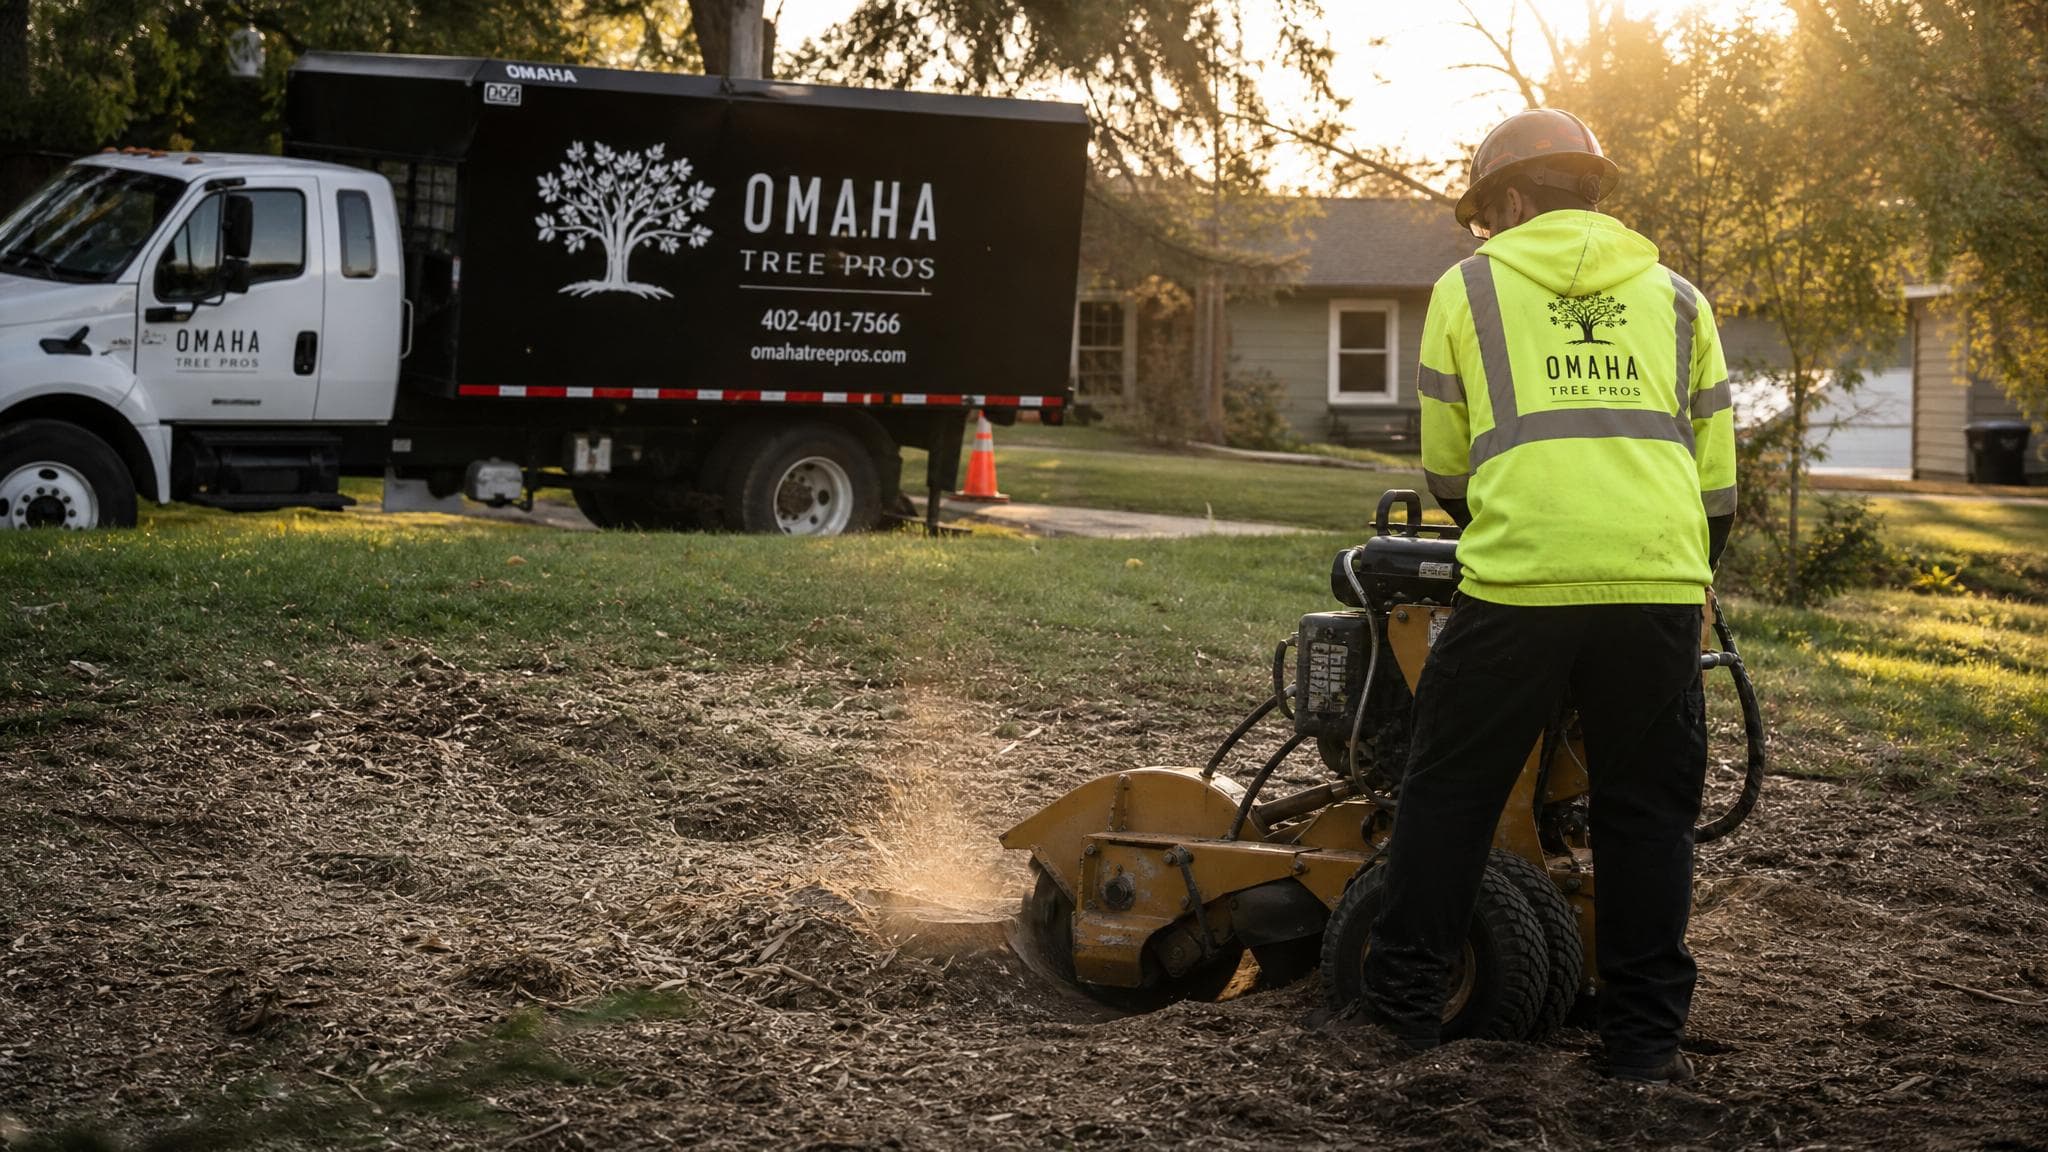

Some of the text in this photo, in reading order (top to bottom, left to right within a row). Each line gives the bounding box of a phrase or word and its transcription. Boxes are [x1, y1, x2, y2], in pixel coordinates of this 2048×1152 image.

[506, 64, 577, 83] OMAHA
[744, 172, 936, 241] OMAHA
[740, 249, 935, 279] TREE PROS
[761, 309, 901, 334] 402-401-7566
[176, 329, 260, 353] OMAHA
[175, 358, 259, 368] TREE PROS
[751, 342, 907, 366] omahatreepros.com
[1546, 355, 1638, 380] OMAHA
[1549, 385, 1641, 396] TREE PROS
